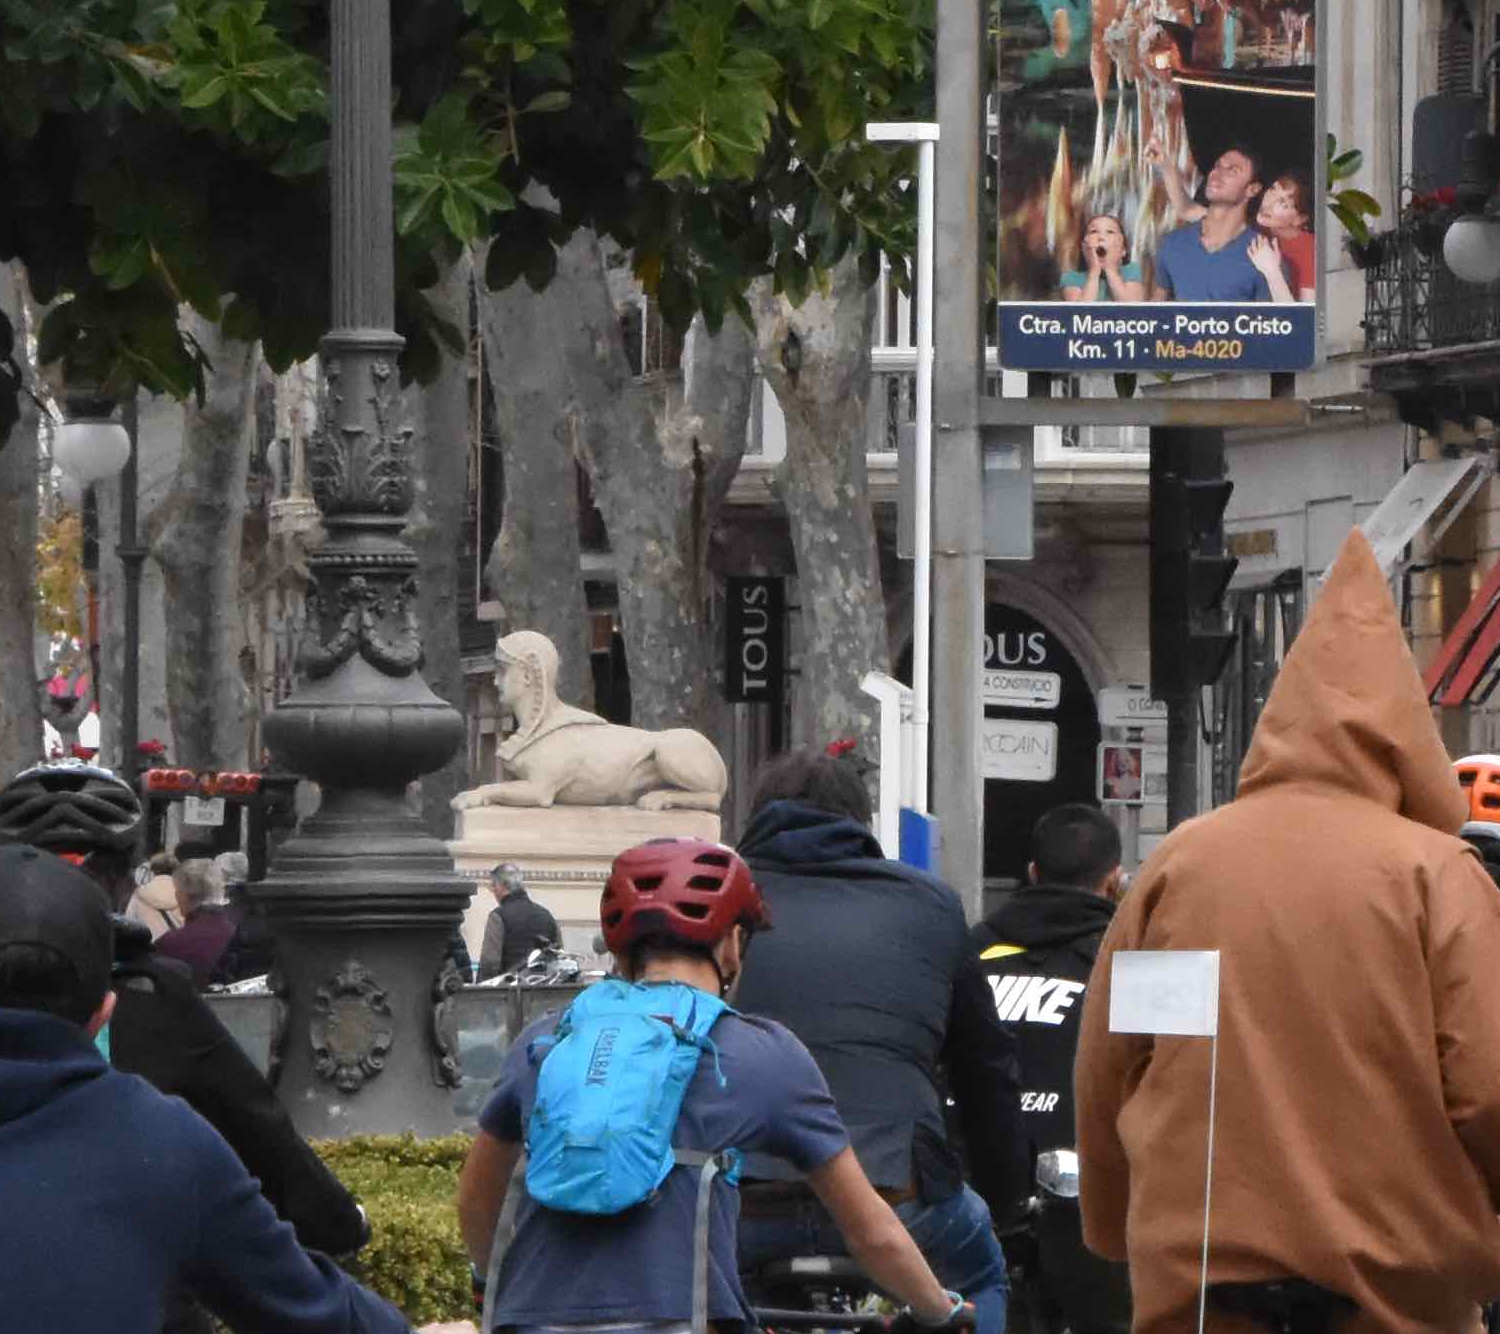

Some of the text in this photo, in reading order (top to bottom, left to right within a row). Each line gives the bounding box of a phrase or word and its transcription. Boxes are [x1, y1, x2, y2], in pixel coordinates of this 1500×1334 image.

[1019, 315, 1066, 335] Ctra.
[1073, 315, 1157, 334] Manacor
[1175, 315, 1229, 334] Porto
[1234, 315, 1292, 335] Cristo
[1068, 340, 1106, 359] Km.
[1113, 340, 1136, 359] 11
[1155, 340, 1242, 358] Ma-4020
[742, 585, 768, 696] TOUS
